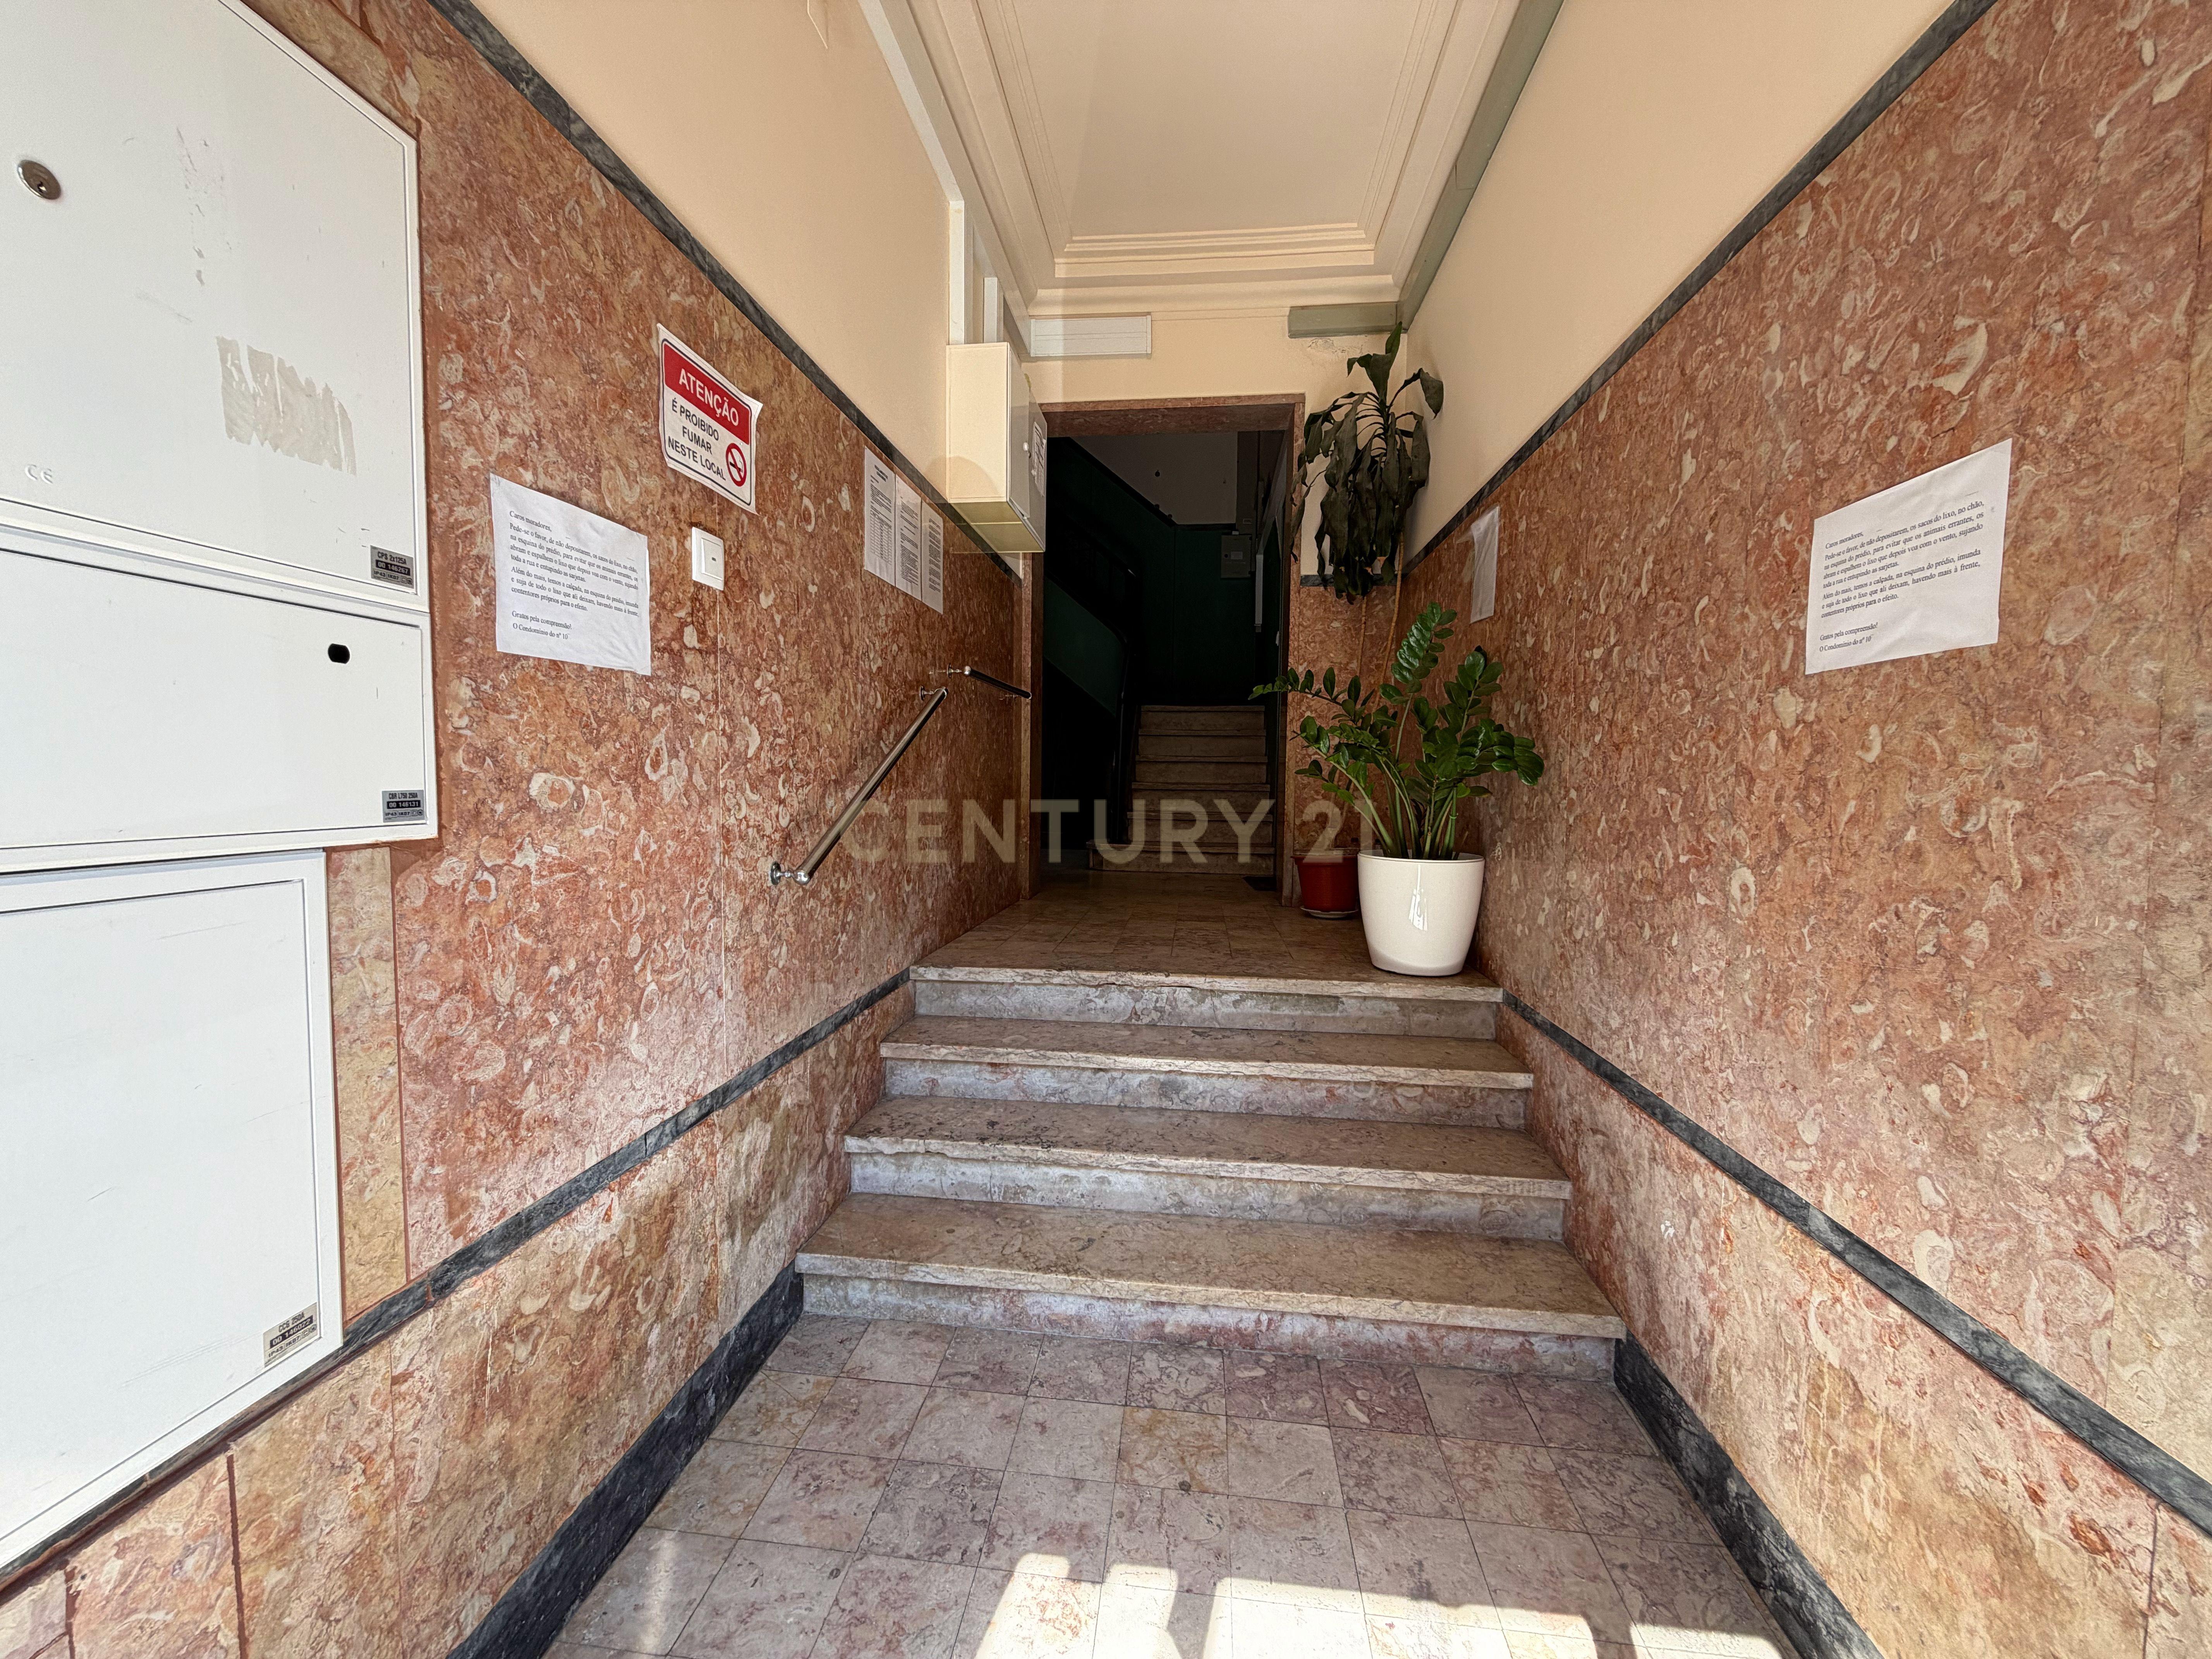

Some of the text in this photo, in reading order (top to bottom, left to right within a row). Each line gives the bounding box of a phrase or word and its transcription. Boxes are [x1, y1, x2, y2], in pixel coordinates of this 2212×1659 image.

[679, 368, 739, 426] ATENÇÃO
[672, 398, 719, 441] É PROIBIDO
[682, 426, 712, 455] FUMAR
[668, 435, 726, 481] NESTE LOCAL
[509, 510, 525, 521] Caros
[1918, 518, 1933, 529] sacos
[1958, 507, 1966, 515] no
[509, 522, 530, 535] Pede-se
[518, 537, 537, 548] esquina
[1872, 546, 1884, 555] para
[1885, 539, 1901, 549] evitar
[1903, 536, 1913, 546] que
[1923, 524, 1946, 537] animais
[1877, 554, 1888, 563] que
[1888, 547, 1906, 558] depois
[1919, 541, 1932, 549] com
[1958, 523, 1983, 537] sujando
[377, 551, 388, 560] CPS
[510, 544, 526, 554] abram
[531, 551, 553, 563] espalhem
[558, 559, 567, 567] lixo
[510, 554, 522, 563] toda
[539, 564, 563, 575] entupindo
[1903, 566, 1925, 577] esquina
[1957, 548, 1981, 561] imunda
[511, 566, 525, 576] Além
[548, 577, 562, 586] temos
[1911, 572, 1936, 584] havendo
[1937, 567, 1952, 577] mais
[511, 587, 540, 599] contentores
[540, 594, 560, 604] próprios
[516, 578, 527, 586] suja
[553, 587, 562, 595] lixo
[1865, 599, 1877, 608] para
[512, 610, 529, 620] Gratos
[540, 618, 572, 630] compreensão!
[272, 1336, 283, 1346] 00
[268, 1345, 283, 1358] IP43
